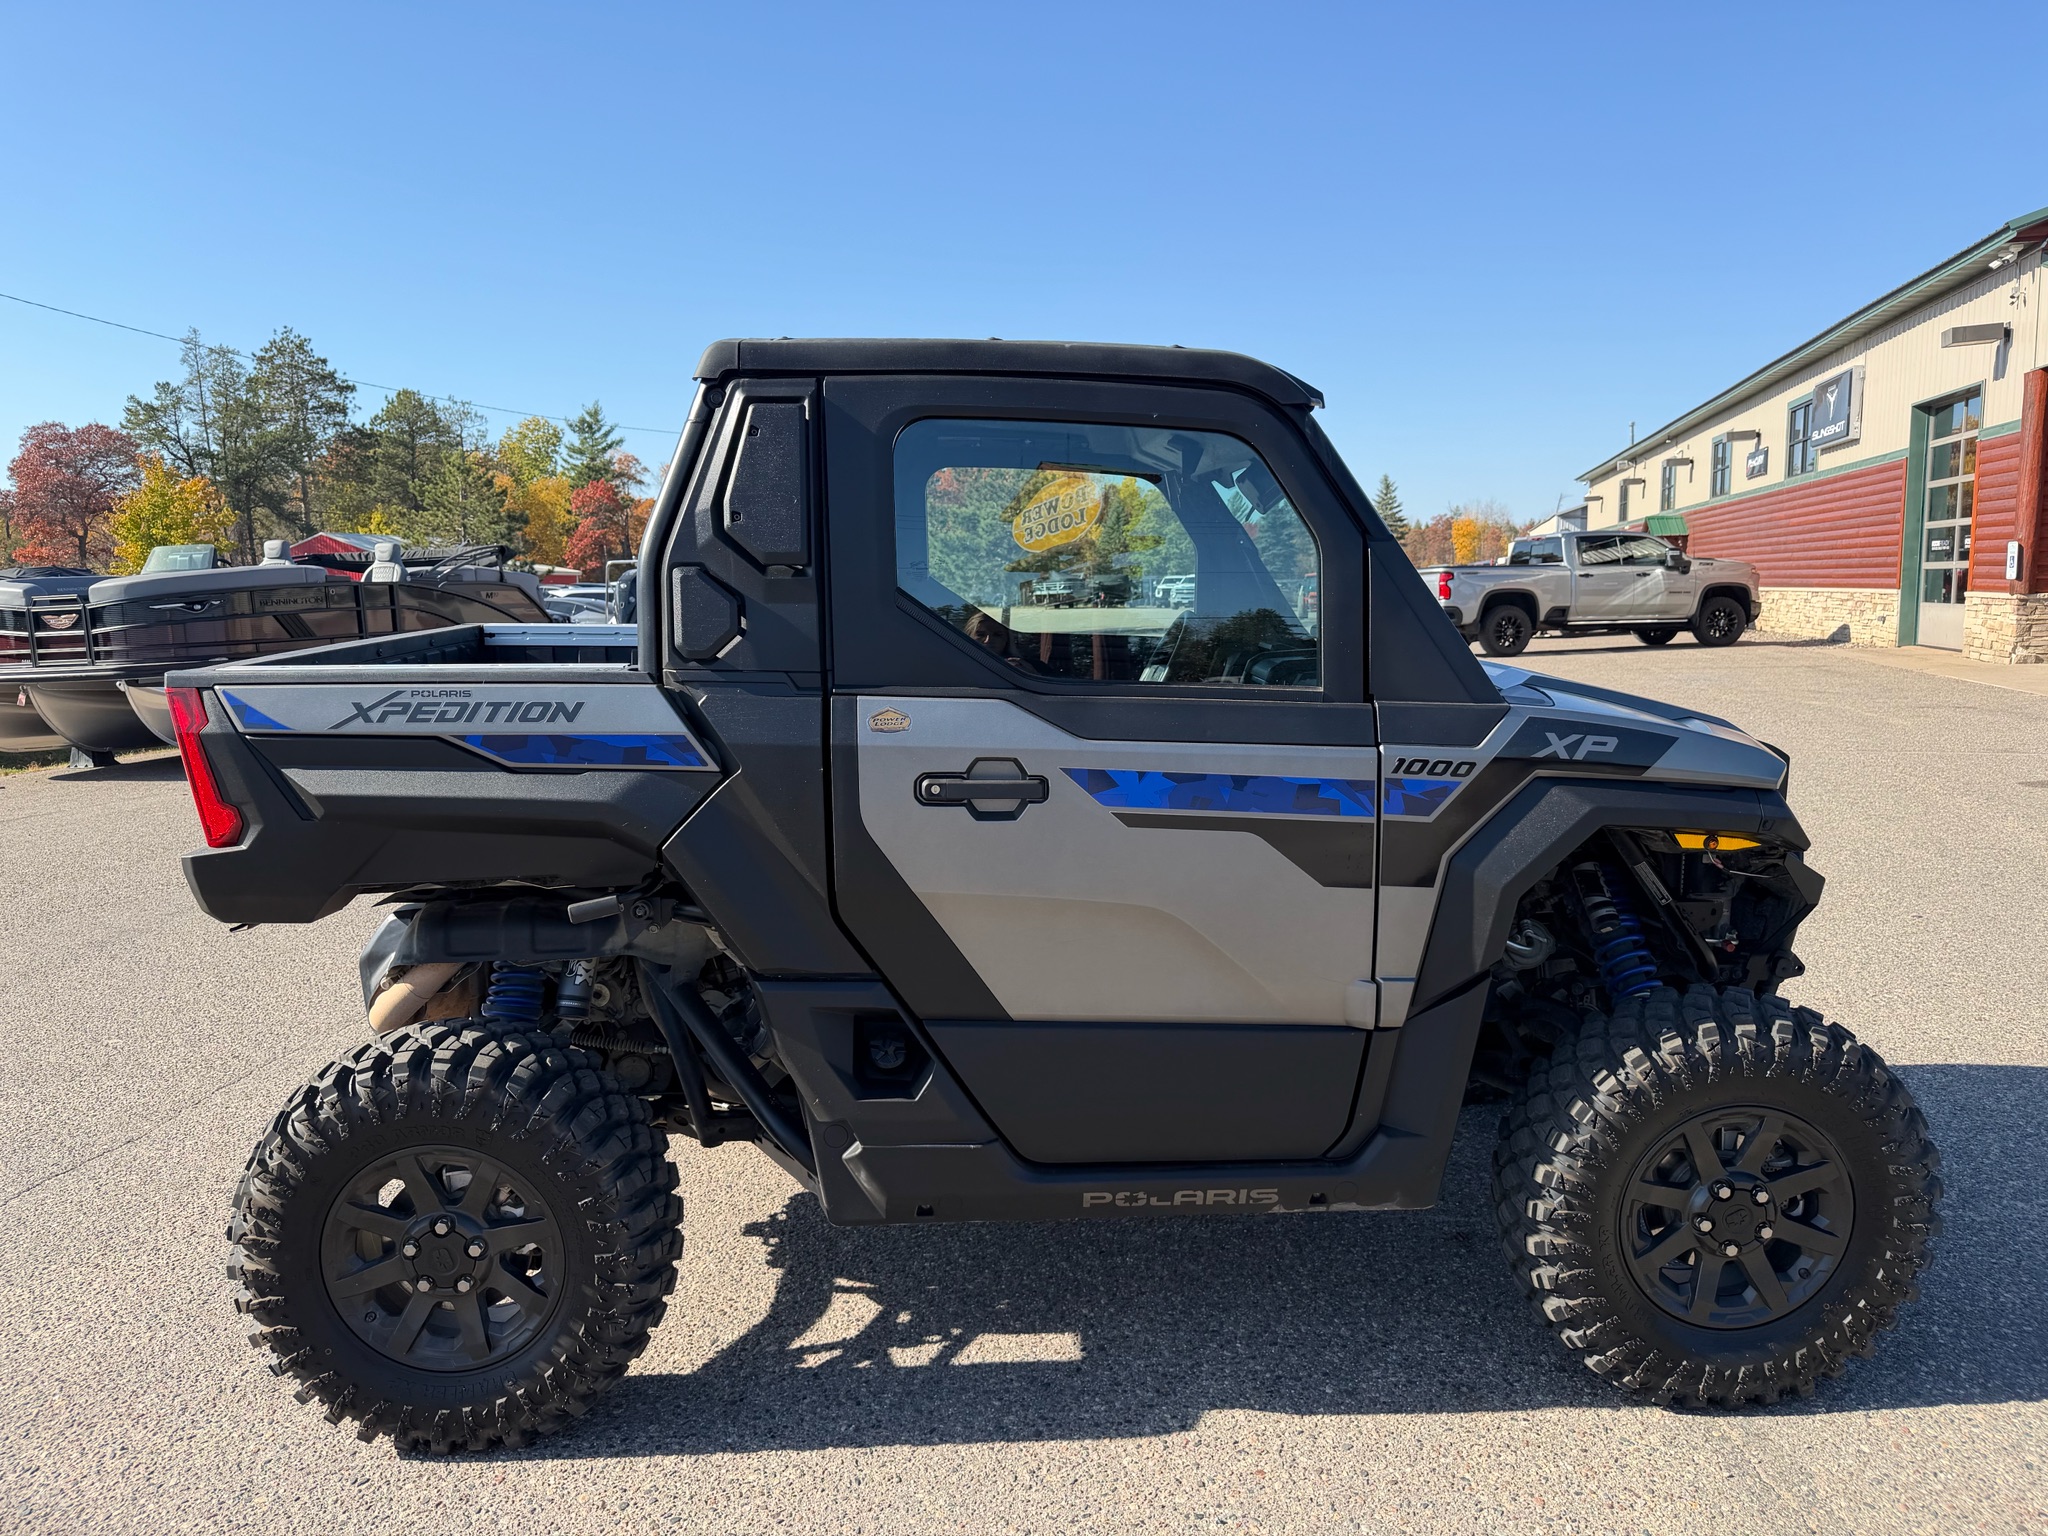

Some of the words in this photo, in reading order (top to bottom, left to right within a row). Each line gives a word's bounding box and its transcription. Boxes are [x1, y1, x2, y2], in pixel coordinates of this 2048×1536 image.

[1811, 420, 1846, 441] SLINGSHOT
[259, 595, 324, 607] BENNINGTON
[410, 689, 472, 698] POLARIS
[324, 690, 586, 730] XPEDITION
[1530, 731, 1619, 761] XP
[1390, 756, 1478, 778] 1000
[1082, 1187, 1280, 1208] POLARIS
